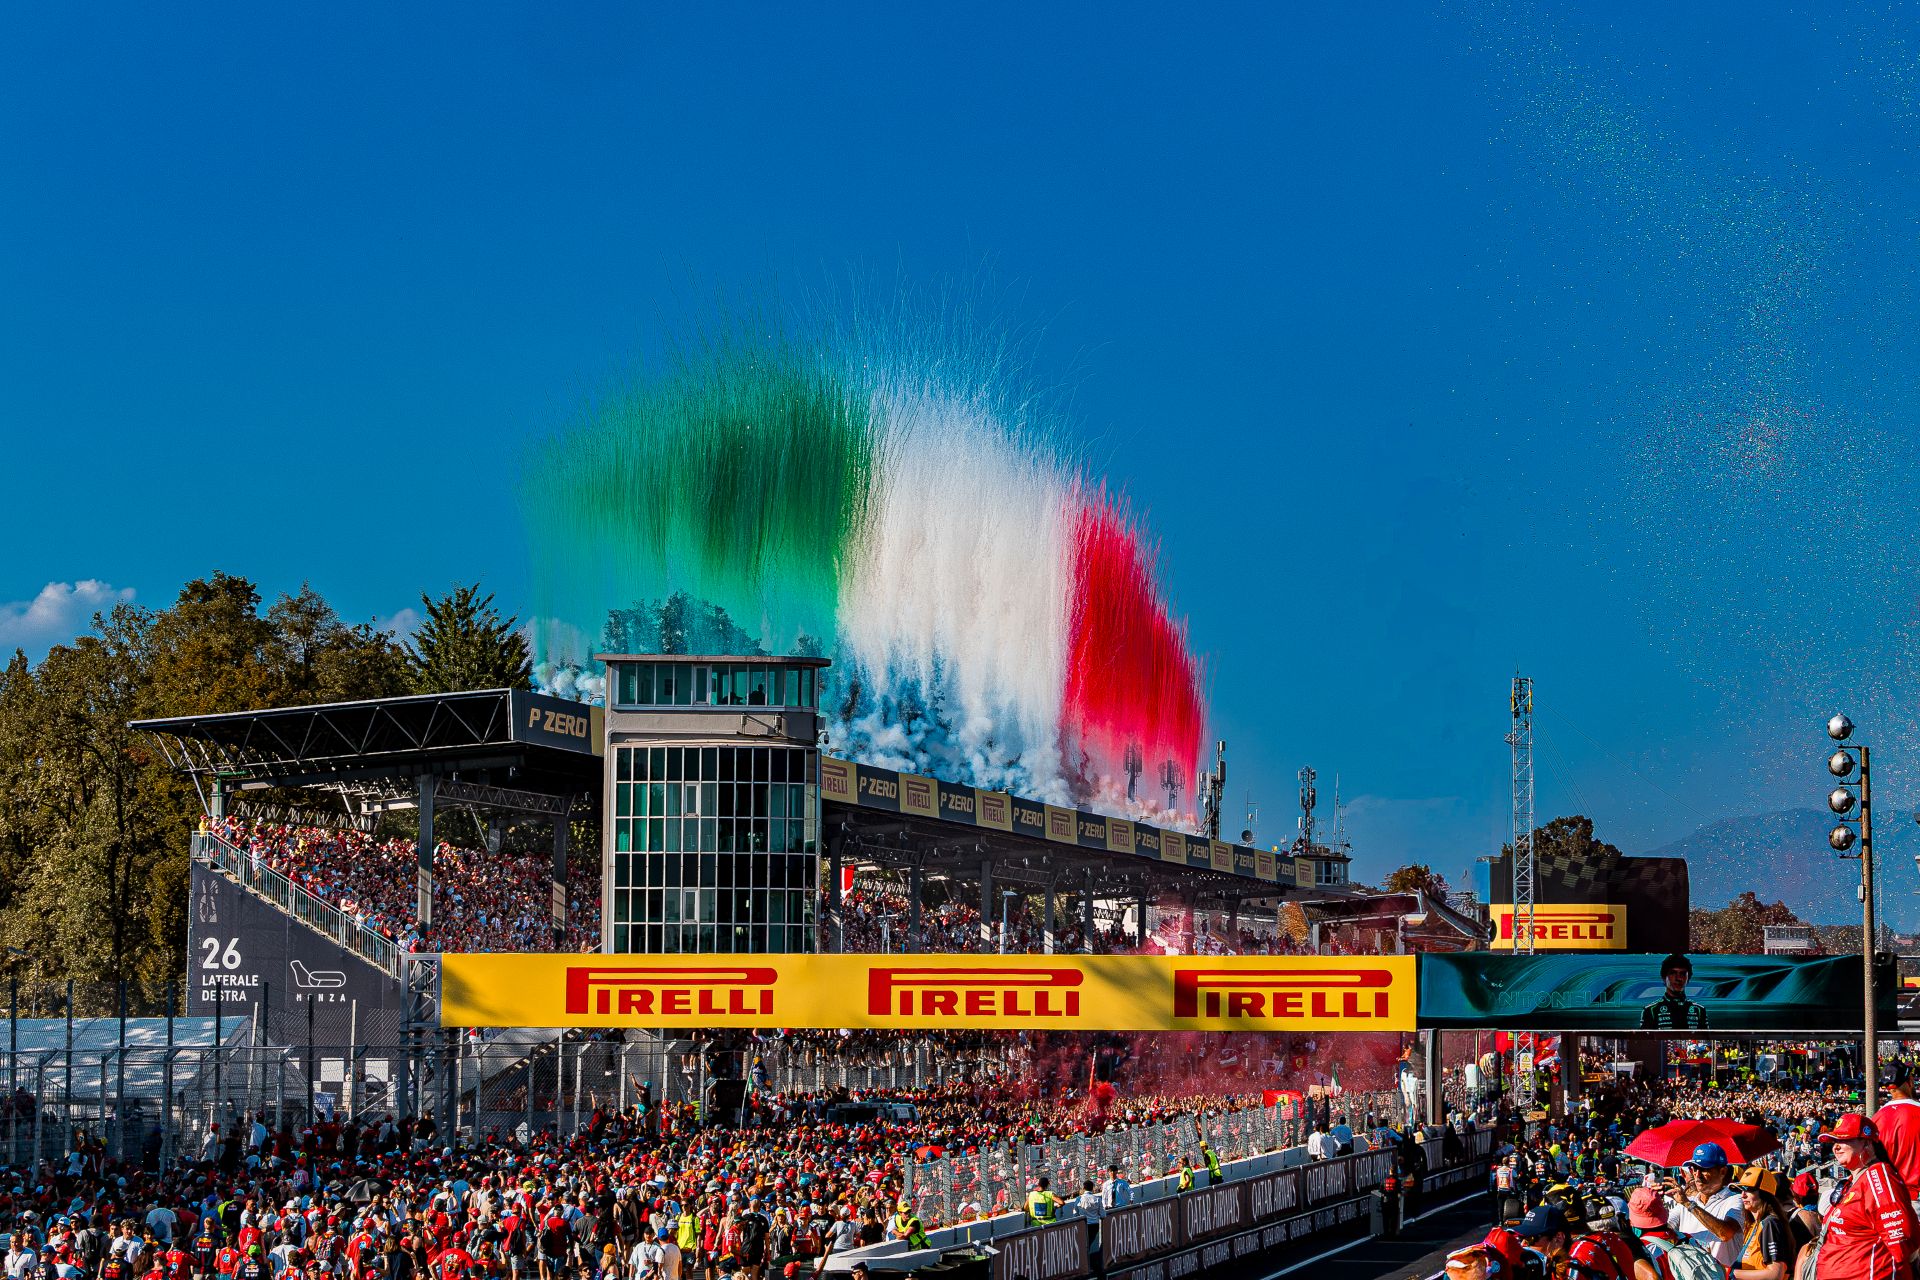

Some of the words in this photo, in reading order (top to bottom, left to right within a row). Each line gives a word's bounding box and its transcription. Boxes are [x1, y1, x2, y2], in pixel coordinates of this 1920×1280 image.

[529, 707, 541, 728] P
[543, 710, 587, 738] ZERO
[859, 776, 867, 793] P
[868, 777, 897, 799] ZERO
[906, 780, 931, 810] PIRELLI
[940, 792, 947, 807] P
[948, 793, 974, 813] ZERO
[982, 795, 1005, 824] PIRELLI
[1013, 807, 1020, 822] P
[1020, 810, 1043, 828] ZERO
[1051, 811, 1072, 837] PIRELLI
[1078, 821, 1084, 835] P
[1084, 823, 1105, 839] ZERO
[1135, 831, 1141, 845] P
[1141, 833, 1160, 850] ZERO
[1187, 843, 1193, 856] P
[1193, 844, 1209, 859] ZERO
[1501, 913, 1615, 939] PIRELLI
[202, 937, 242, 970] 26
[202, 974, 259, 987] LATERALE
[565, 966, 778, 1015] PIRELLI
[868, 967, 1084, 1016] PIRELLI
[1173, 969, 1393, 1018] PIRELLI
[1187, 1193, 1211, 1240] QATAR
[1213, 1186, 1240, 1229] AIRWAYS
[1251, 1179, 1273, 1222] QATAR
[1110, 1212, 1139, 1263] QATAR
[1140, 1204, 1173, 1252] AIRWAYS
[1003, 1235, 1039, 1280] QATAR
[1042, 1225, 1080, 1279] AIRWAYS
